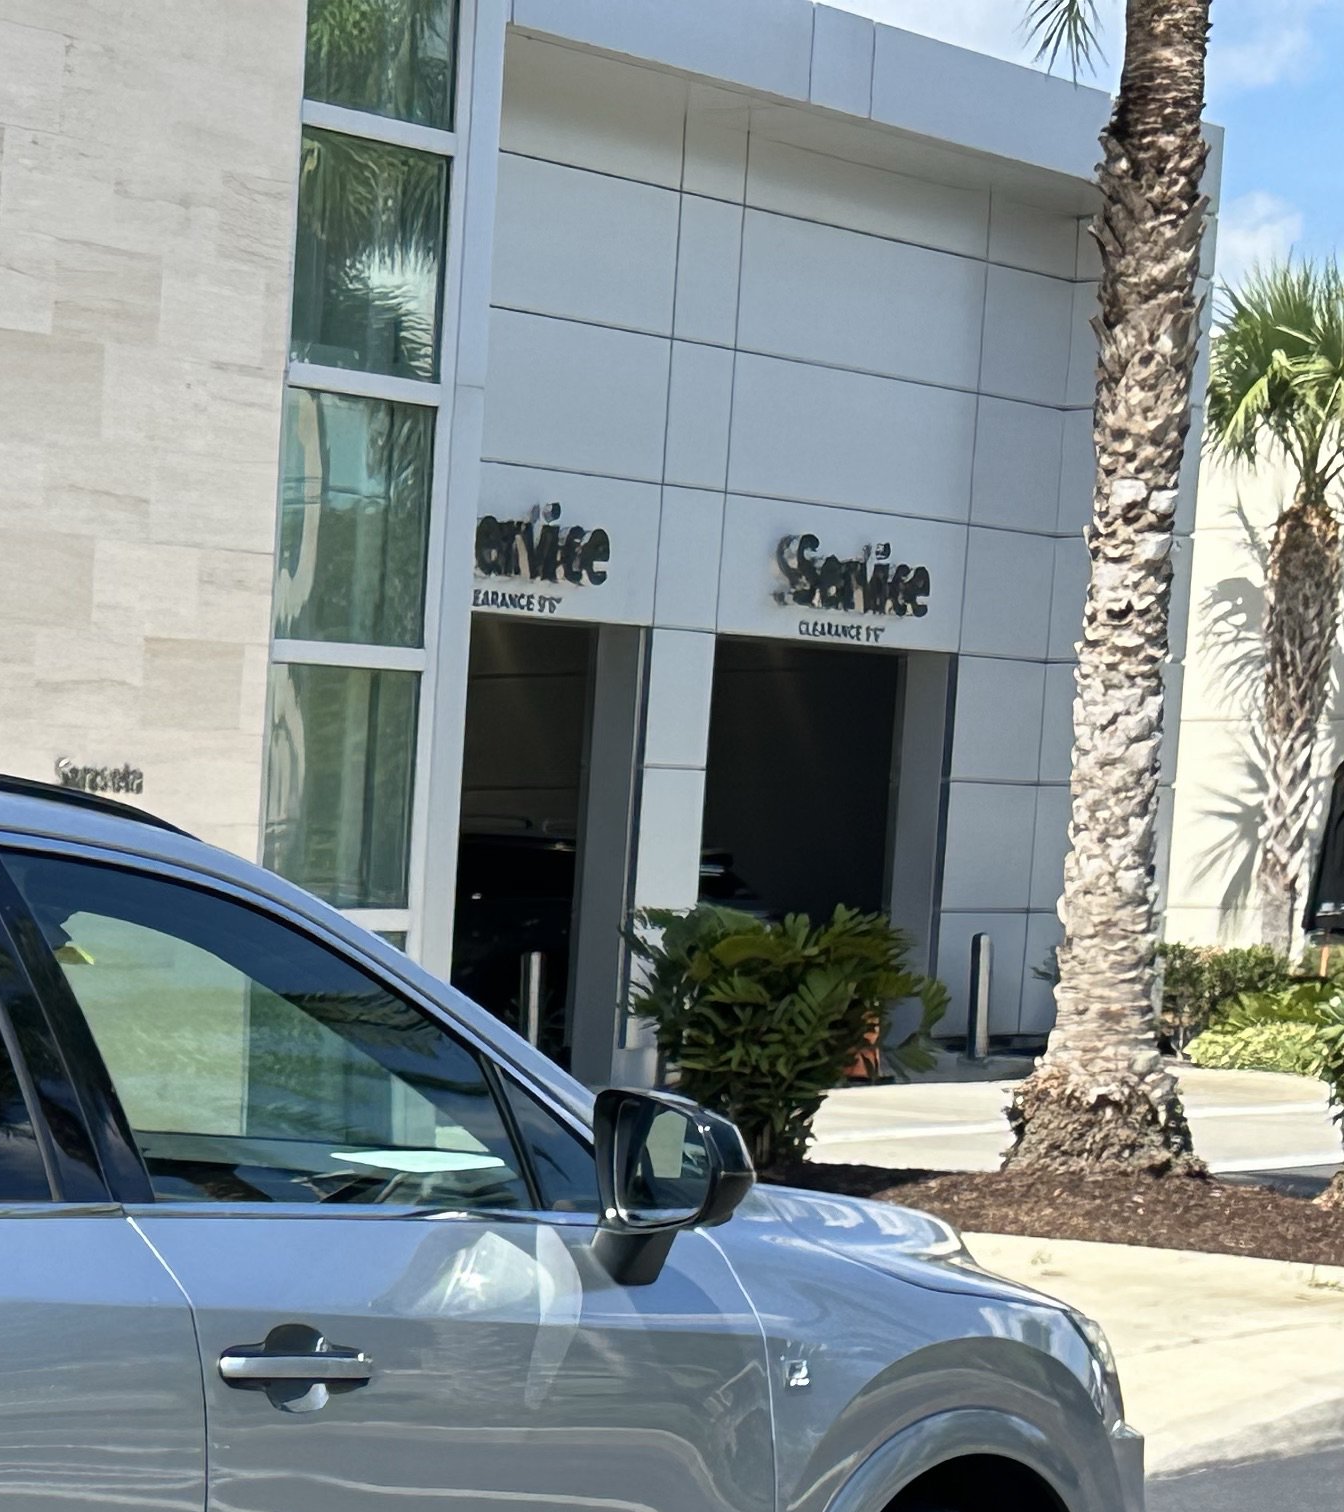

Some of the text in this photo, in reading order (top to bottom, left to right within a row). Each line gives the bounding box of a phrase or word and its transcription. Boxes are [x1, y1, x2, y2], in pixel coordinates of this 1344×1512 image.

[475, 502, 610, 586] ervice
[775, 533, 930, 618] Service
[472, 588, 535, 612] EARANCE
